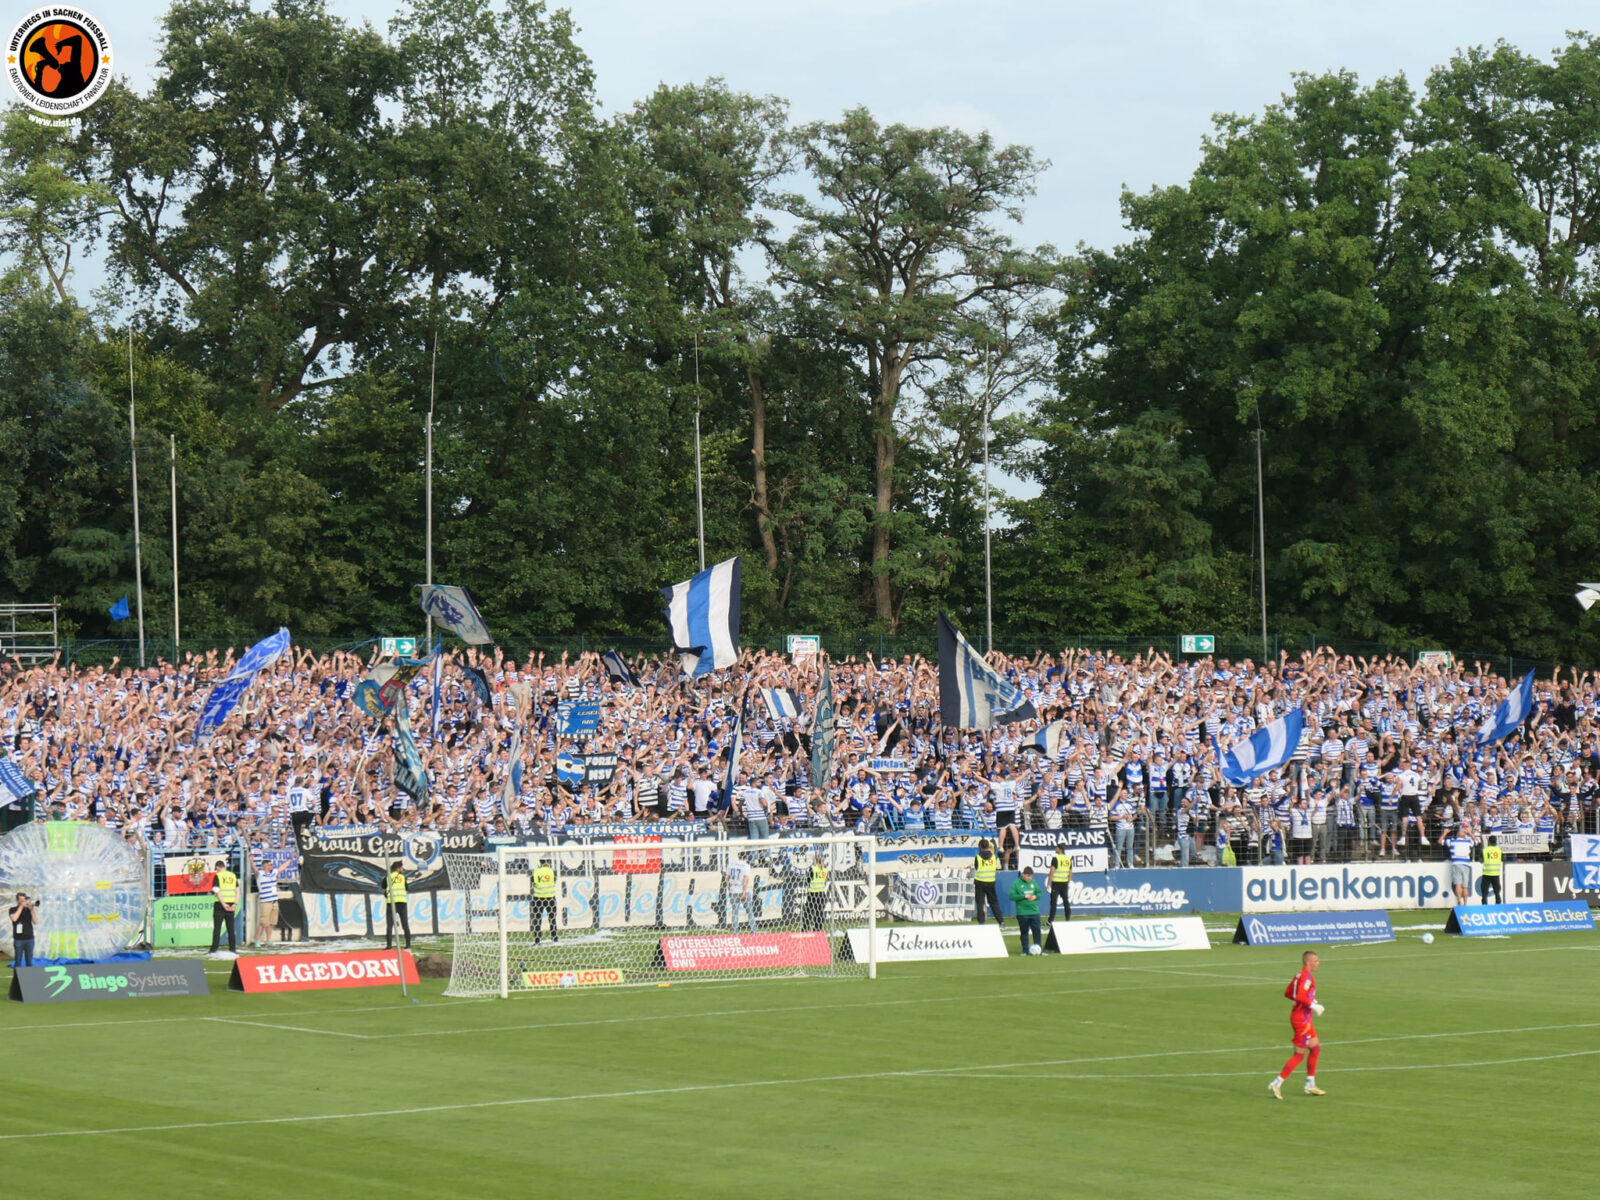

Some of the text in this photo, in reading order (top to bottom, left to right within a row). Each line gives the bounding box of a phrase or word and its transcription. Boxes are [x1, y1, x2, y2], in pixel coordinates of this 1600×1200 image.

[585, 756, 618, 766] FORZA
[588, 768, 612, 780] MSV
[290, 793, 302, 806] 07
[303, 833, 478, 856] Proud Genion
[1020, 831, 1105, 846] ZEBRAFANS
[1486, 835, 1541, 845] DAUHERDE
[1032, 853, 1094, 868] DÜMEN
[1045, 877, 1189, 909] Meesenburg
[1471, 908, 1588, 926] euronics Bücker
[162, 921, 214, 930] IM HEIDEWA
[1086, 922, 1177, 943] TÖNNIES
[1268, 924, 1297, 932] Friedrich
[1337, 921, 1356, 930] GmbH
[1376, 920, 1388, 928] KG
[668, 936, 741, 950] GÜTERSLOHER
[886, 929, 973, 952] Rickmann
[668, 946, 779, 959] WERTSTOFFZENTRUM
[672, 958, 696, 968] GWG
[256, 958, 400, 984] HAGEDORN
[528, 970, 618, 986] WEST LOTTO
[78, 972, 187, 992] Bingo Systems
